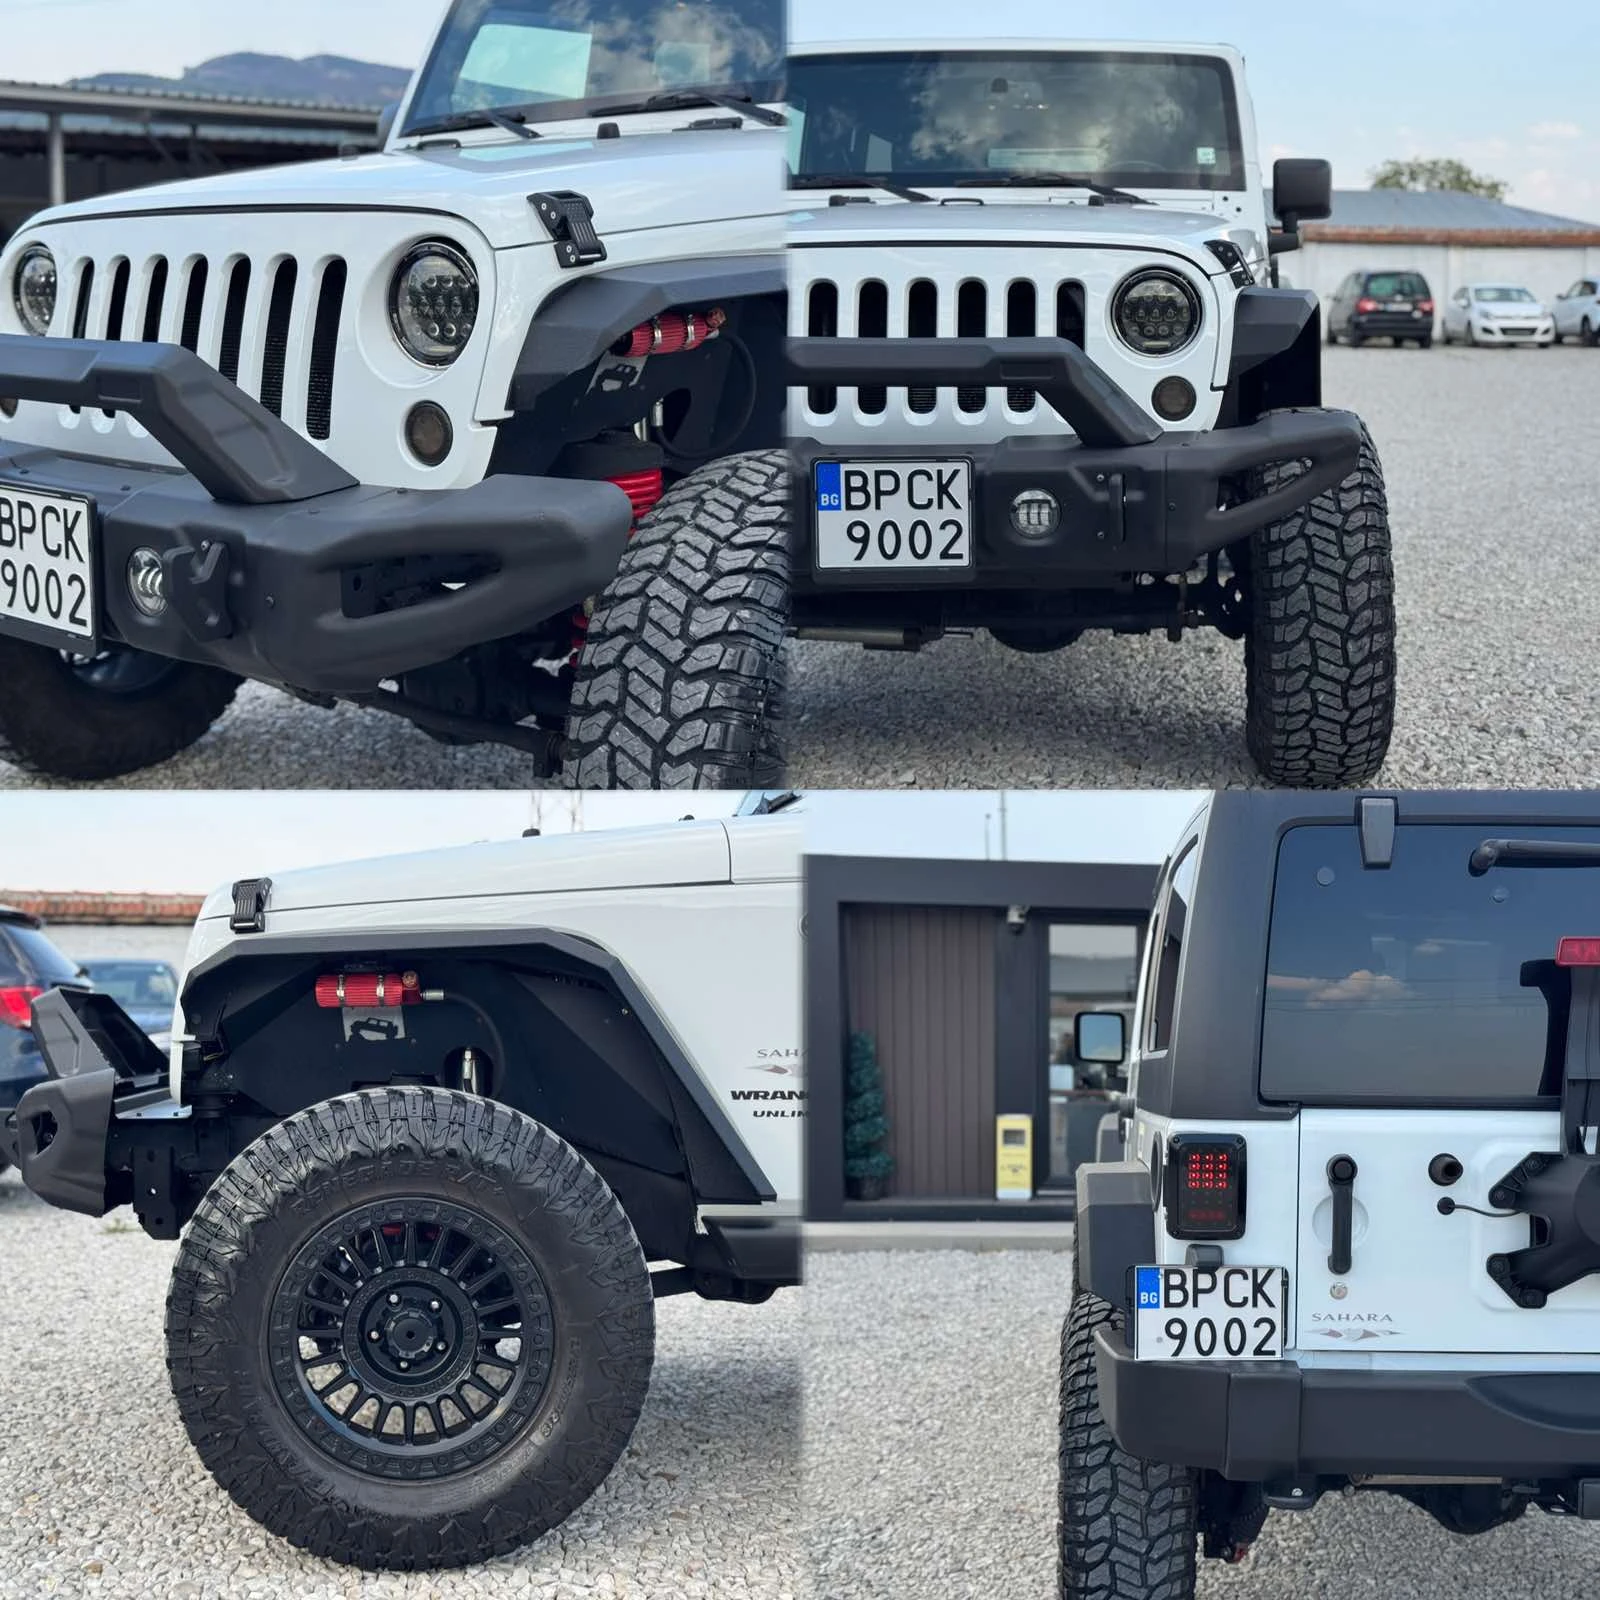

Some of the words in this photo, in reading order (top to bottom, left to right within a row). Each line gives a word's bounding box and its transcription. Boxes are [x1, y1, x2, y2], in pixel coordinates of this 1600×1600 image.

[821, 494, 839, 506] BG
[845, 469, 963, 510] BPCK
[0, 497, 84, 563] BPCK
[847, 519, 964, 561] 9002
[1, 559, 87, 627] 9002
[1140, 1291, 1158, 1304] BG
[1164, 1268, 1276, 1308] BPCK
[1165, 1317, 1276, 1357] 9002
[1312, 1313, 1393, 1322] SAHARA
